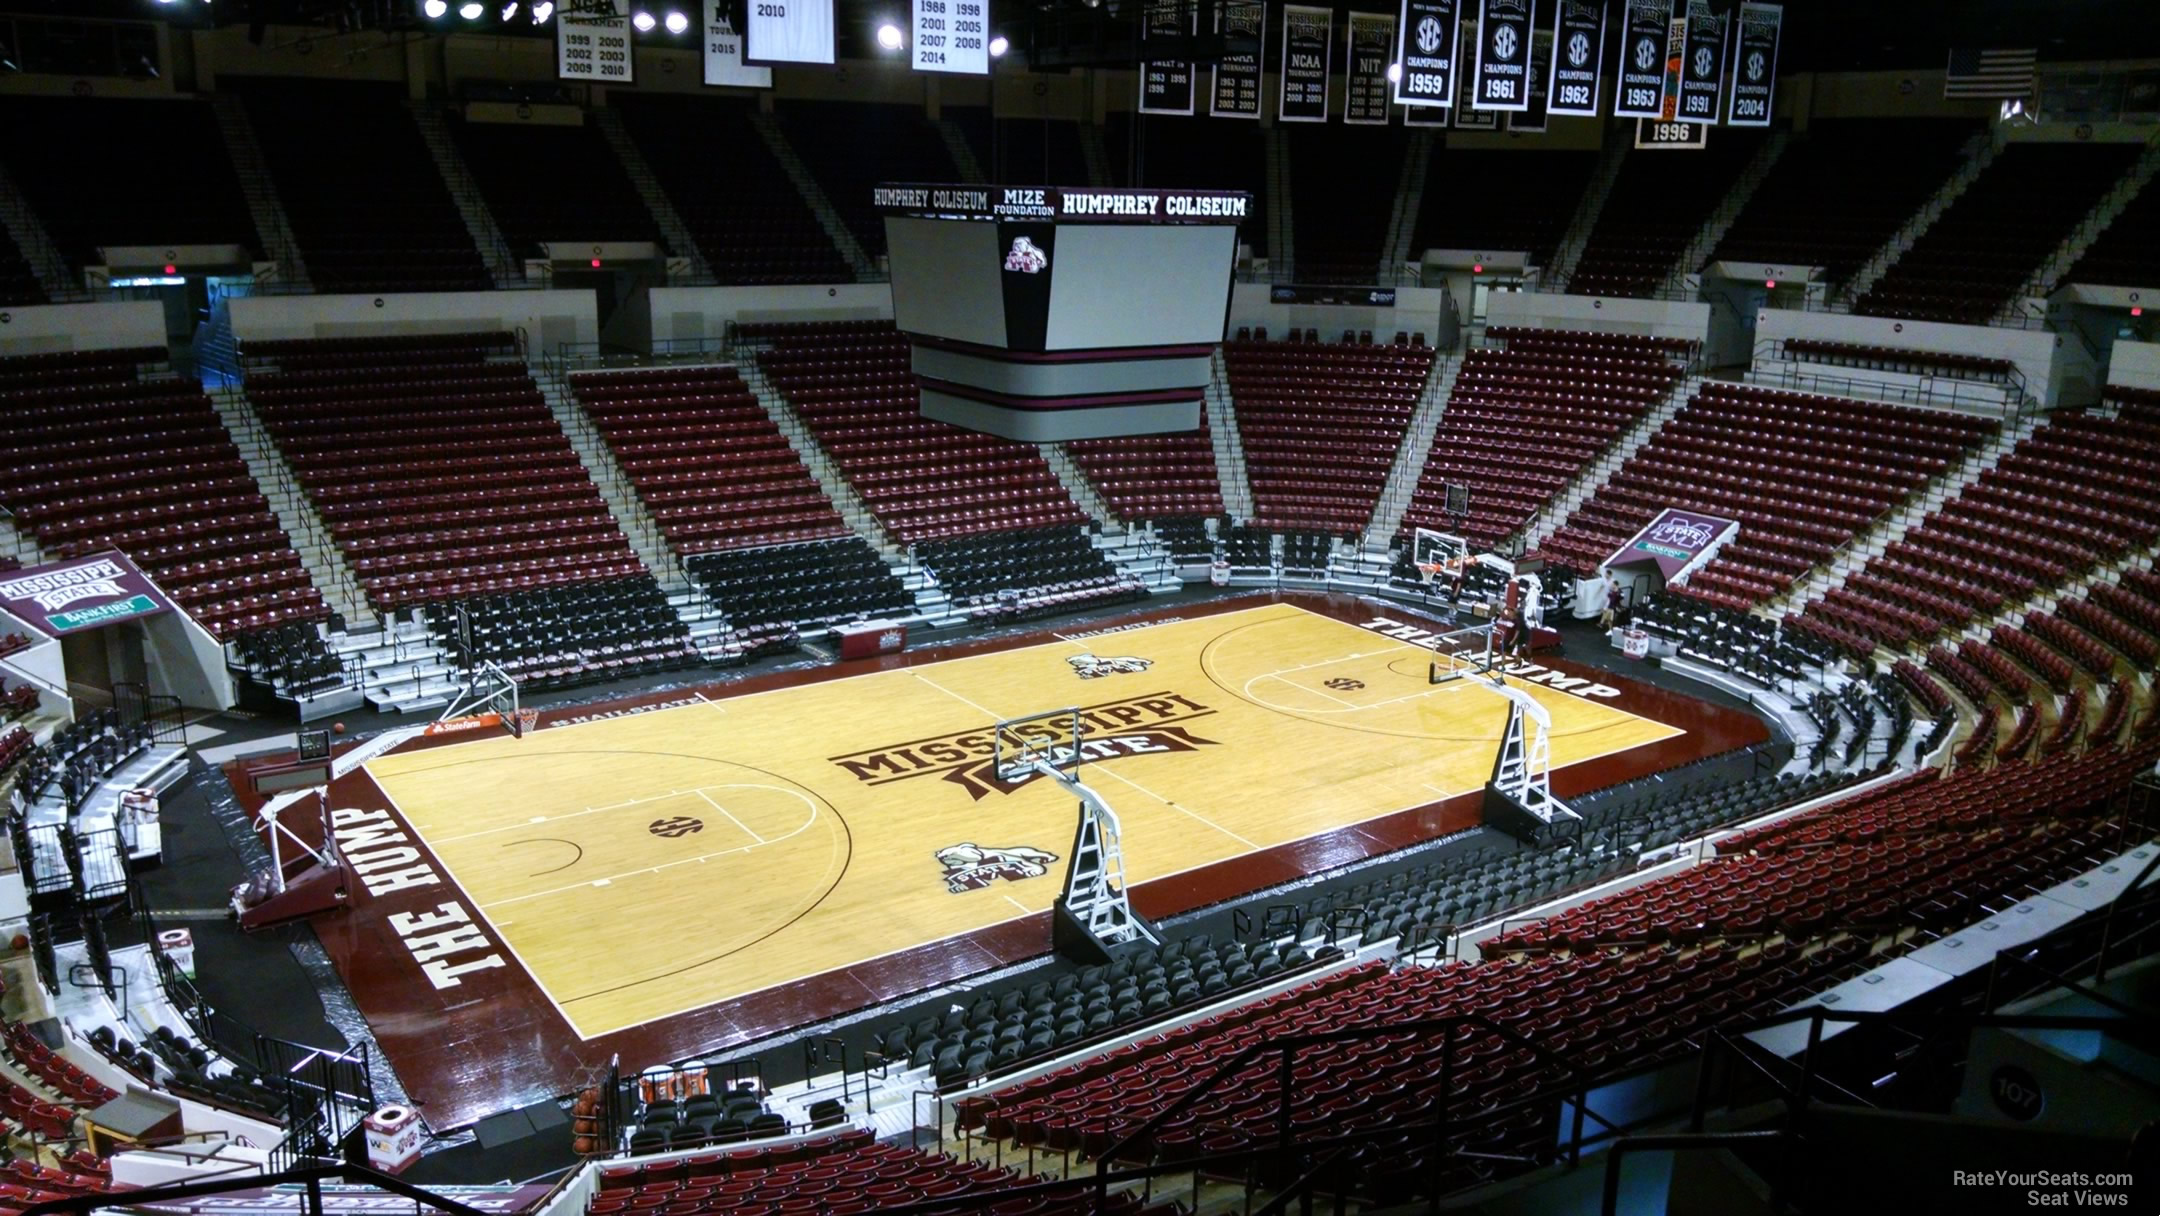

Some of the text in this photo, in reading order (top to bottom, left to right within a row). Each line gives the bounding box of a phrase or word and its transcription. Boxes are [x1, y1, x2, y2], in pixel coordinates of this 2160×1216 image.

[757, 4, 785, 17] 2010
[921, 1, 980, 16] 1988 1998
[921, 18, 981, 33] 2001 2005
[566, 35, 624, 48] 1999 2000
[921, 34, 981, 49] 2007 2008
[1418, 17, 1440, 52] SEC
[1495, 26, 1516, 59] SEC
[566, 48, 625, 61] 2002 2003
[712, 44, 735, 54] 2015
[1569, 33, 1588, 66] SEC
[1636, 37, 1656, 70] SEC
[921, 51, 945, 64] 2014
[1292, 54, 1321, 69] NCAA
[1360, 58, 1381, 73] NIT
[1407, 56, 1449, 70] CHAMPIONS
[1694, 47, 1712, 77] SEC
[567, 62, 624, 76] 2009 2010
[1484, 63, 1523, 75] CHAMPIONS
[1747, 52, 1764, 81] SEC
[1408, 73, 1443, 94] 1959
[1559, 70, 1594, 81] CHAMPIONS
[1625, 74, 1661, 85] CHAMPIONS
[1486, 80, 1515, 99] 1961
[1560, 85, 1589, 104] 1962
[1684, 81, 1717, 92] CHAMPIONS
[1737, 85, 1768, 95] CHAMPIONS
[1627, 88, 1656, 107] 1963
[1686, 96, 1709, 113] 1991
[1737, 100, 1764, 116] 2004
[1653, 124, 1690, 141] 1996
[874, 189, 987, 210] HUMPHREY COLISEUM
[1004, 189, 1045, 205] MIZE
[1063, 194, 1246, 216] HUMPHREY COLISEUM
[994, 205, 1054, 216] FOUNDATION
[1665, 527, 1701, 540] STATE
[0, 560, 123, 598] MISSISSIPPI
[51, 584, 108, 605] STATE
[836, 694, 1208, 780] MISSISSIPPI
[957, 864, 1016, 882] STATE
[331, 808, 506, 990] THE HUMP
